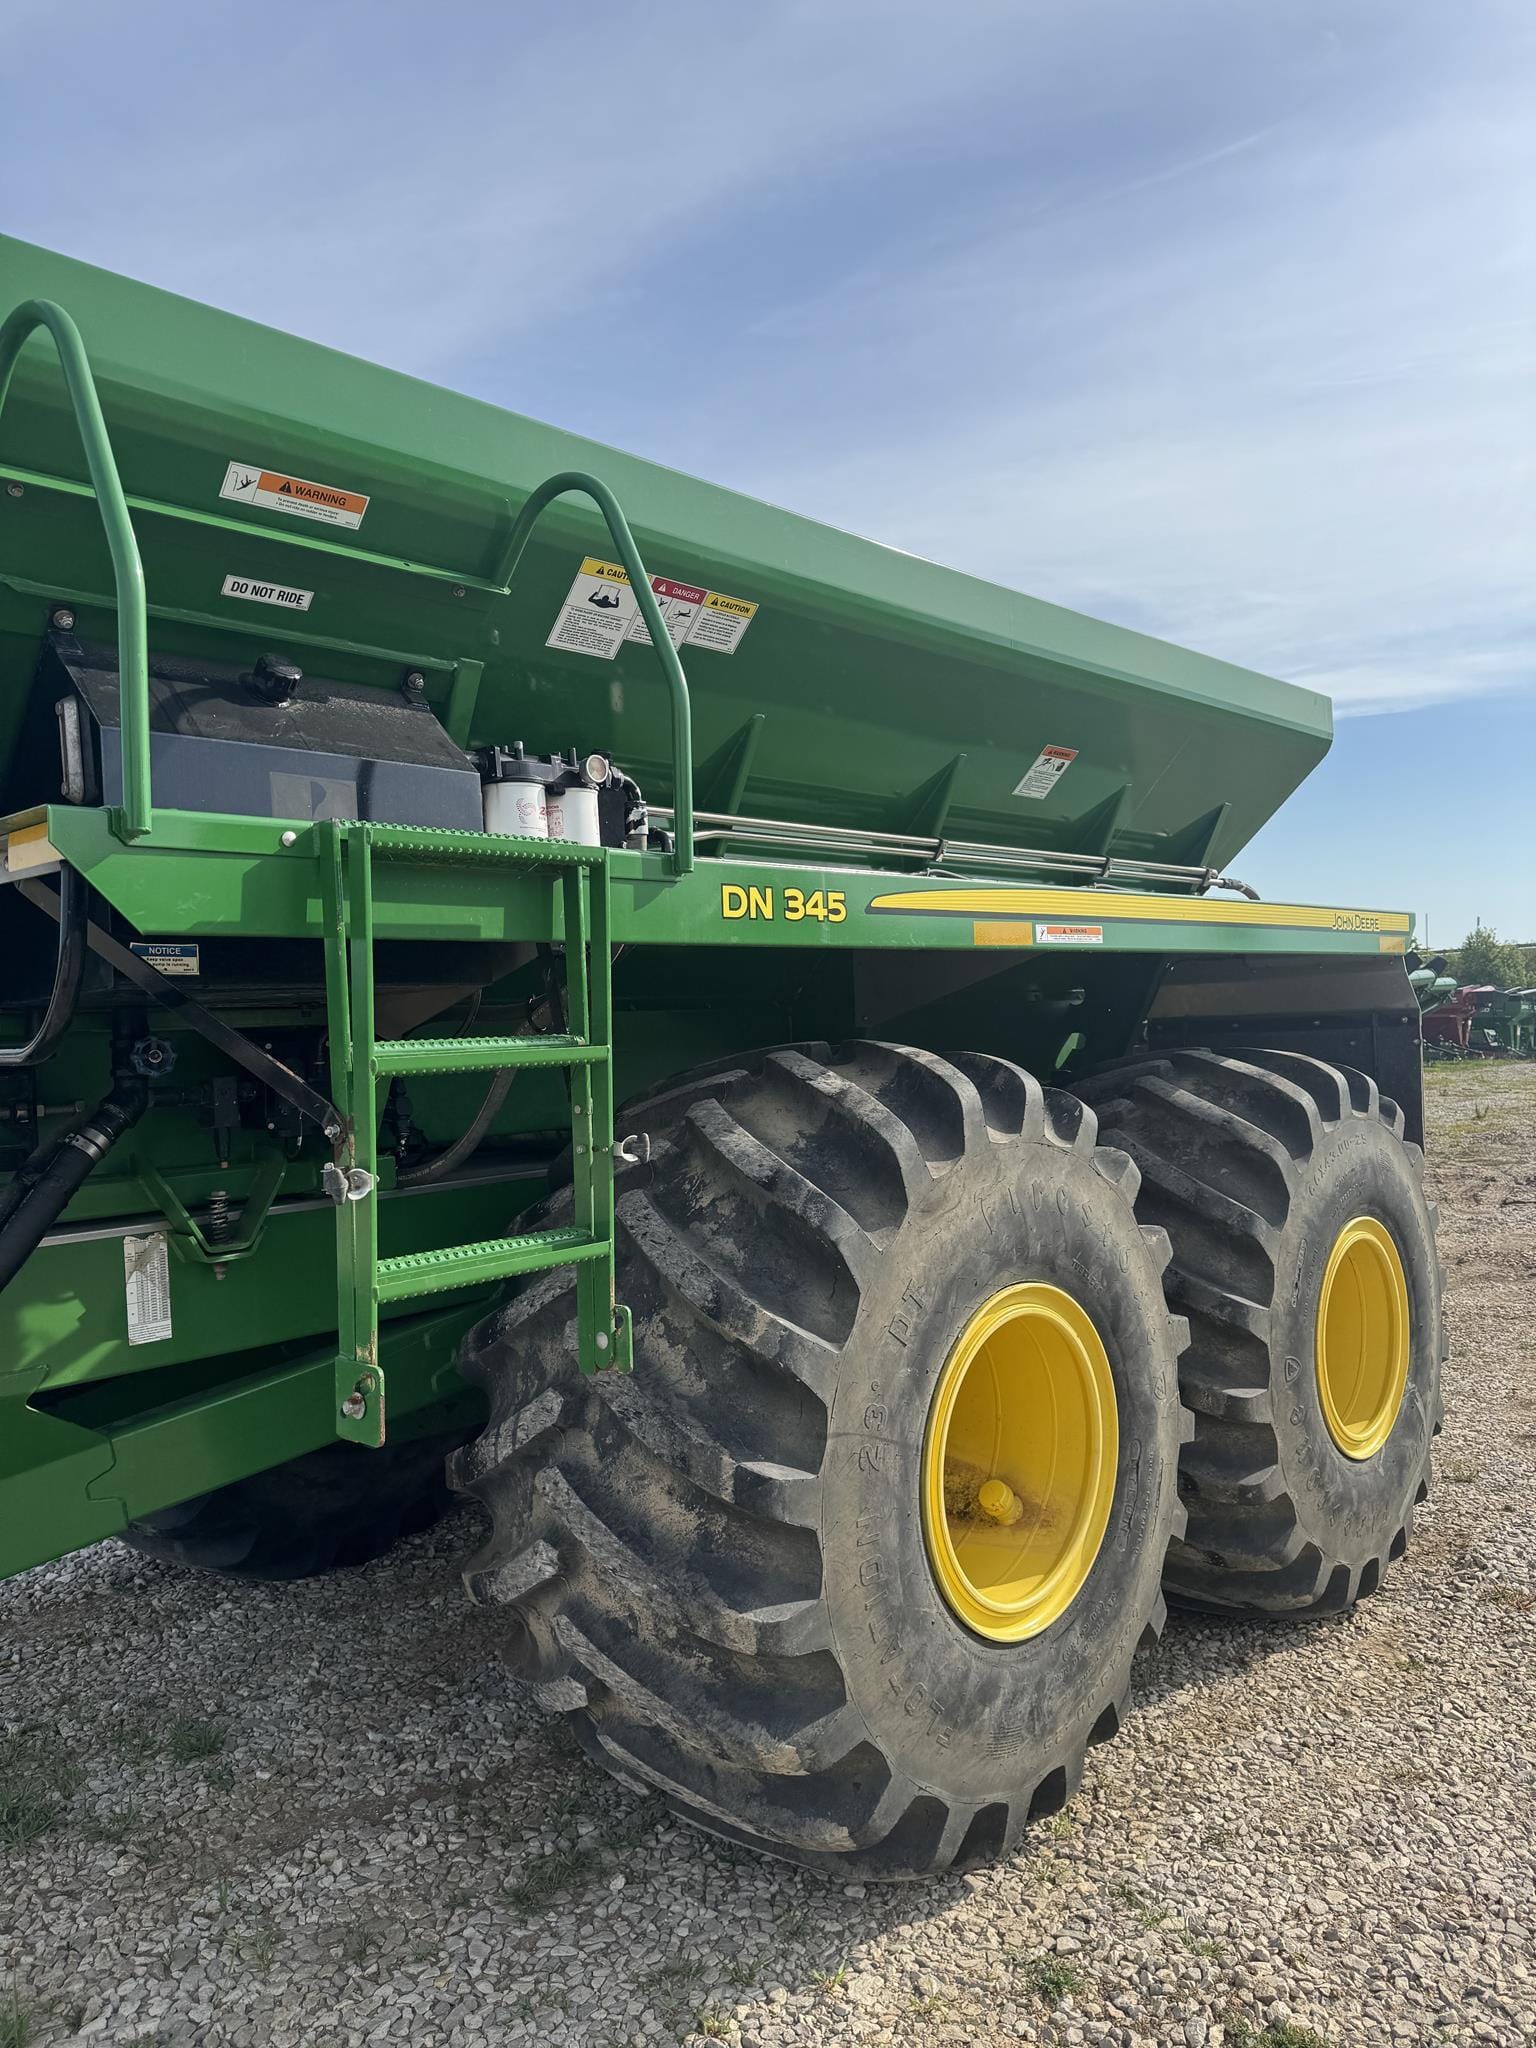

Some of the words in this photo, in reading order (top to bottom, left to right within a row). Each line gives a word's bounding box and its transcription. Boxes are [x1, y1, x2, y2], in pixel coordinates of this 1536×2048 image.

[295, 485, 347, 506] WARNING
[606, 568, 629, 580] CAUT
[231, 581, 248, 593] DO
[250, 585, 276, 599] NOT
[277, 590, 305, 604] RIDE
[672, 587, 700, 600] DANGER
[720, 601, 750, 614] CAUTION
[721, 884, 774, 920] DN
[783, 888, 847, 923] 345
[1333, 913, 1354, 928] JOHN
[1355, 915, 1379, 929] DEERE
[855, 1511, 954, 1750] FLOTATION
